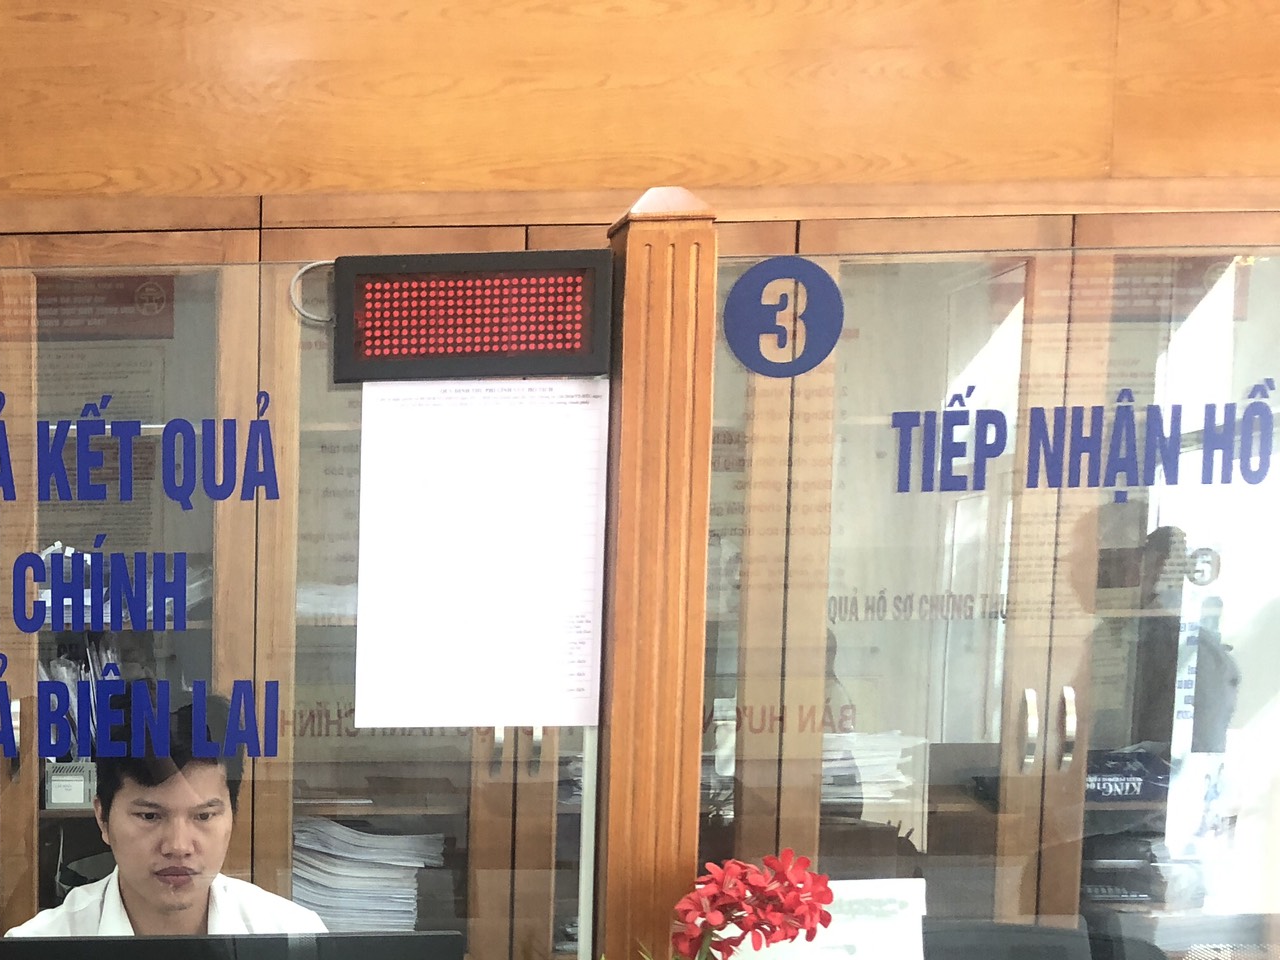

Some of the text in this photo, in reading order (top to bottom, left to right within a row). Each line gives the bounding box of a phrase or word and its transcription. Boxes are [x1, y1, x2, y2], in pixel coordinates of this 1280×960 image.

[759, 278, 809, 363] 3
[36, 394, 142, 502] KẾT
[161, 391, 280, 511] QUẢ
[892, 378, 1276, 504] TIẾP NHẬN HỒ
[13, 533, 187, 633] CHÍNH
[828, 587, 859, 624] QUẢ
[36, 662, 171, 759] BIÊN
[190, 680, 280, 759] LAI
